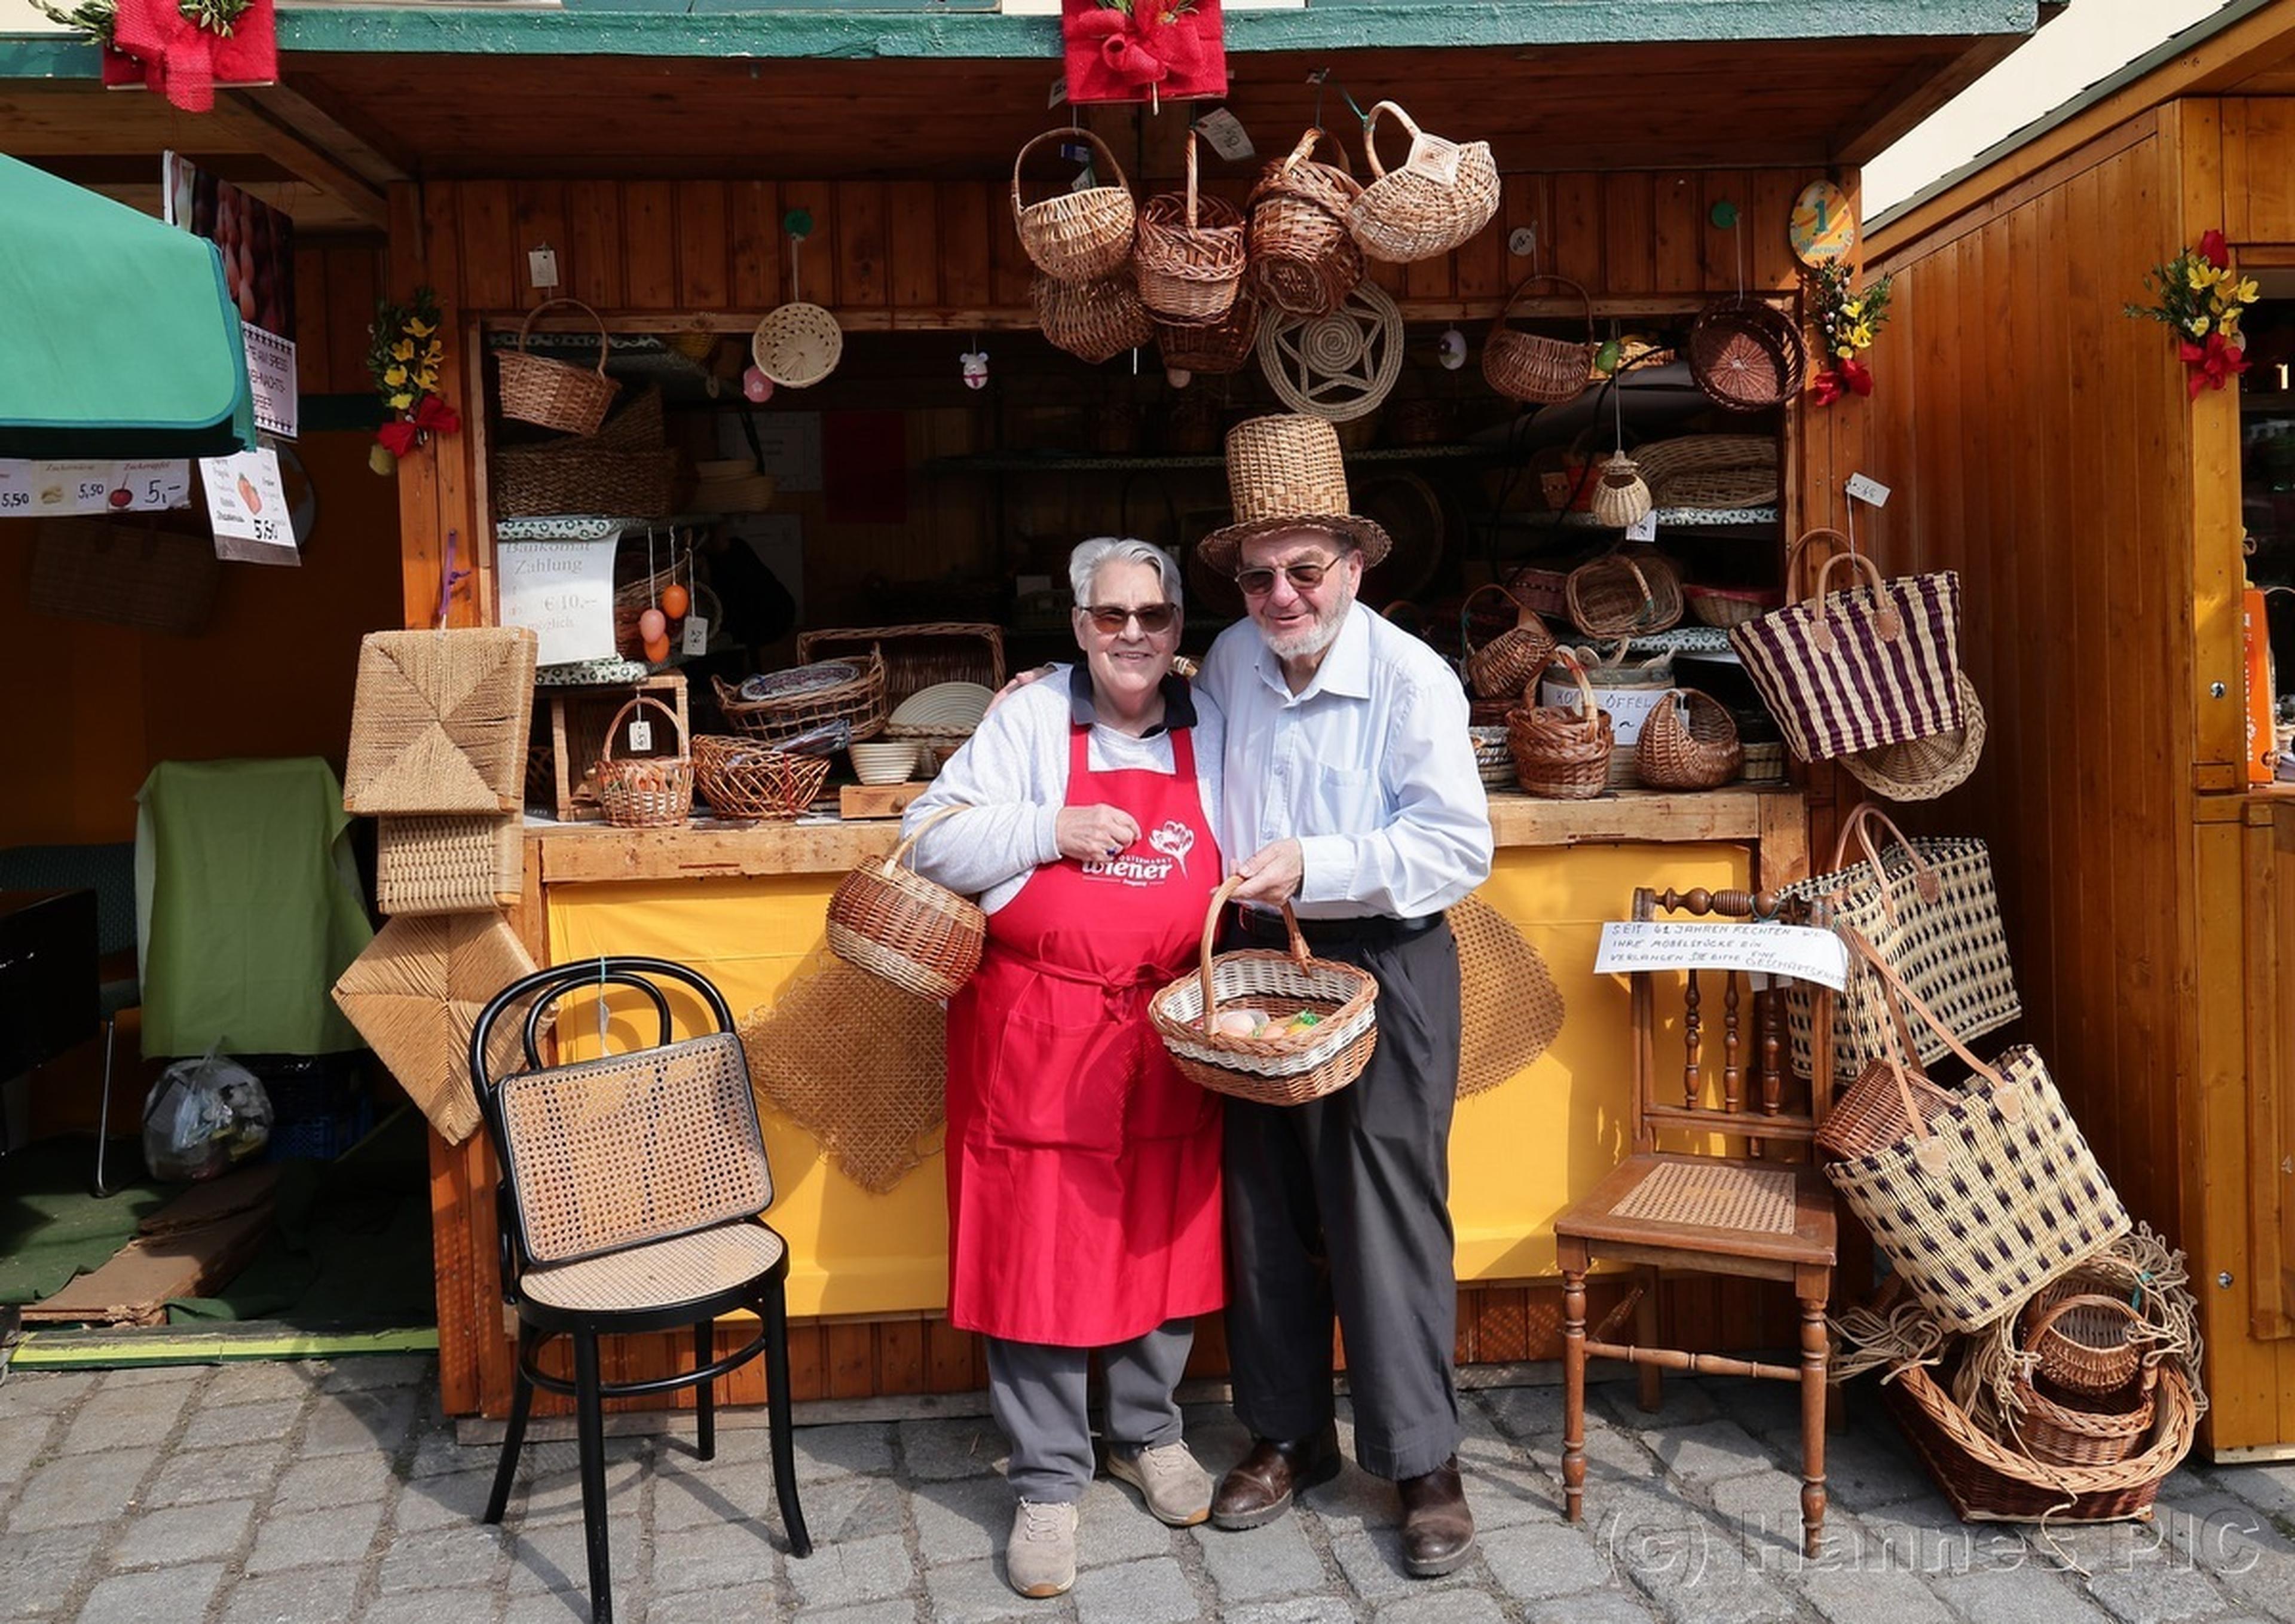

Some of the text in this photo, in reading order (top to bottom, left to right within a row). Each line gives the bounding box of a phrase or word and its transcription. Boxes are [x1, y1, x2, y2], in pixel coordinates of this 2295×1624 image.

[1814, 200, 1829, 232] 1
[78, 483, 104, 498] 5,50
[2, 493, 29, 508] 5,50
[514, 558, 583, 574] Zahlung
[1612, 924, 1643, 935] SEIT
[1674, 925, 1729, 934] JAHREN
